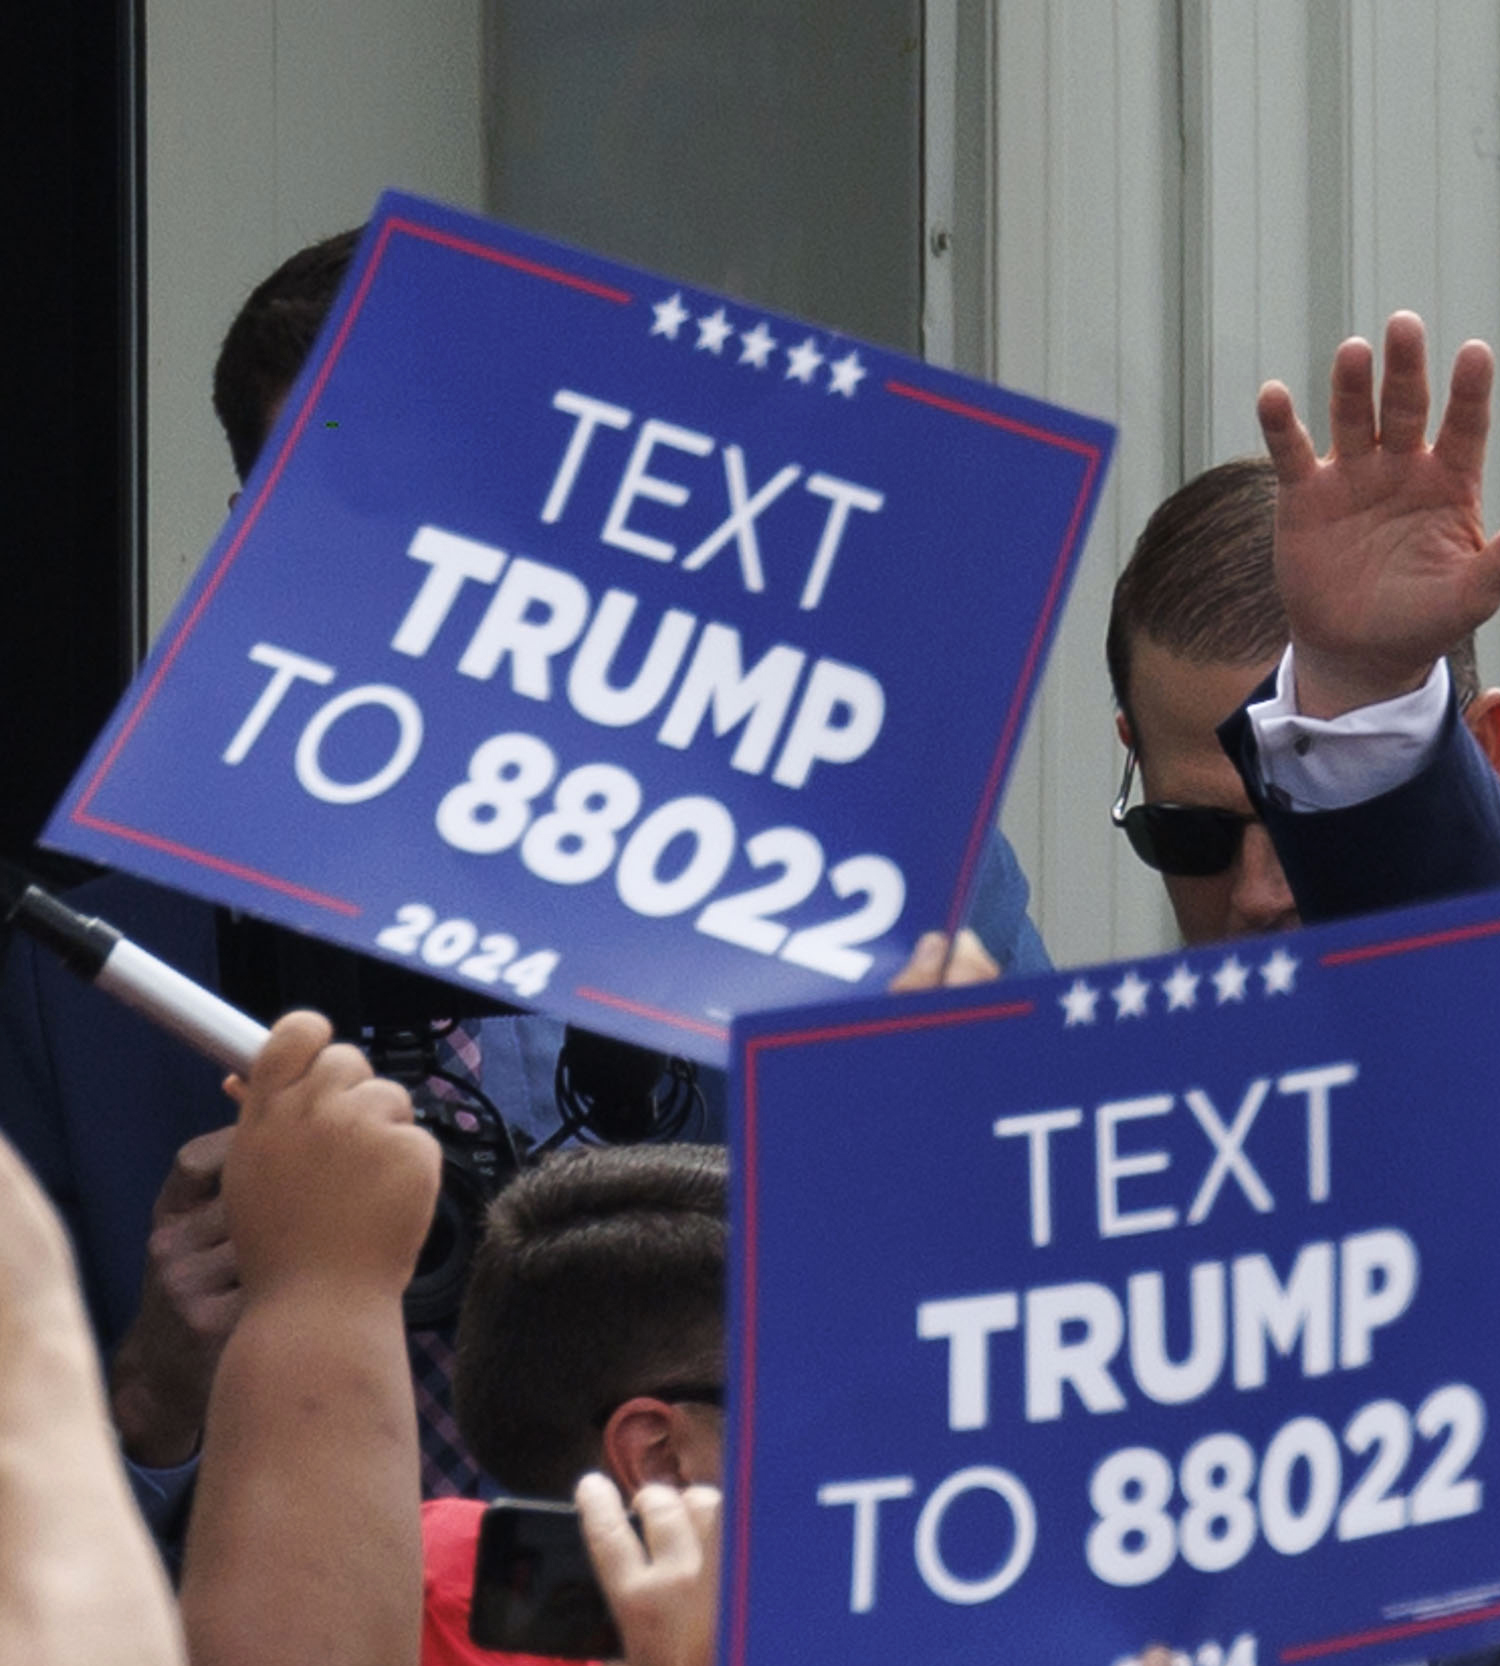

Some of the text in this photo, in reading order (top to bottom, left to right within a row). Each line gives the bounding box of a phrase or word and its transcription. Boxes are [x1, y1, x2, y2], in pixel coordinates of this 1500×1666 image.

[541, 390, 883, 609] TEXT
[391, 525, 884, 788] TRUMP
[222, 642, 905, 985] TO 88022
[374, 902, 561, 998] 2024
[994, 1064, 1356, 1246] TEXT
[917, 1230, 1417, 1430] TRUMP
[818, 1385, 1484, 1612] TO 88022
